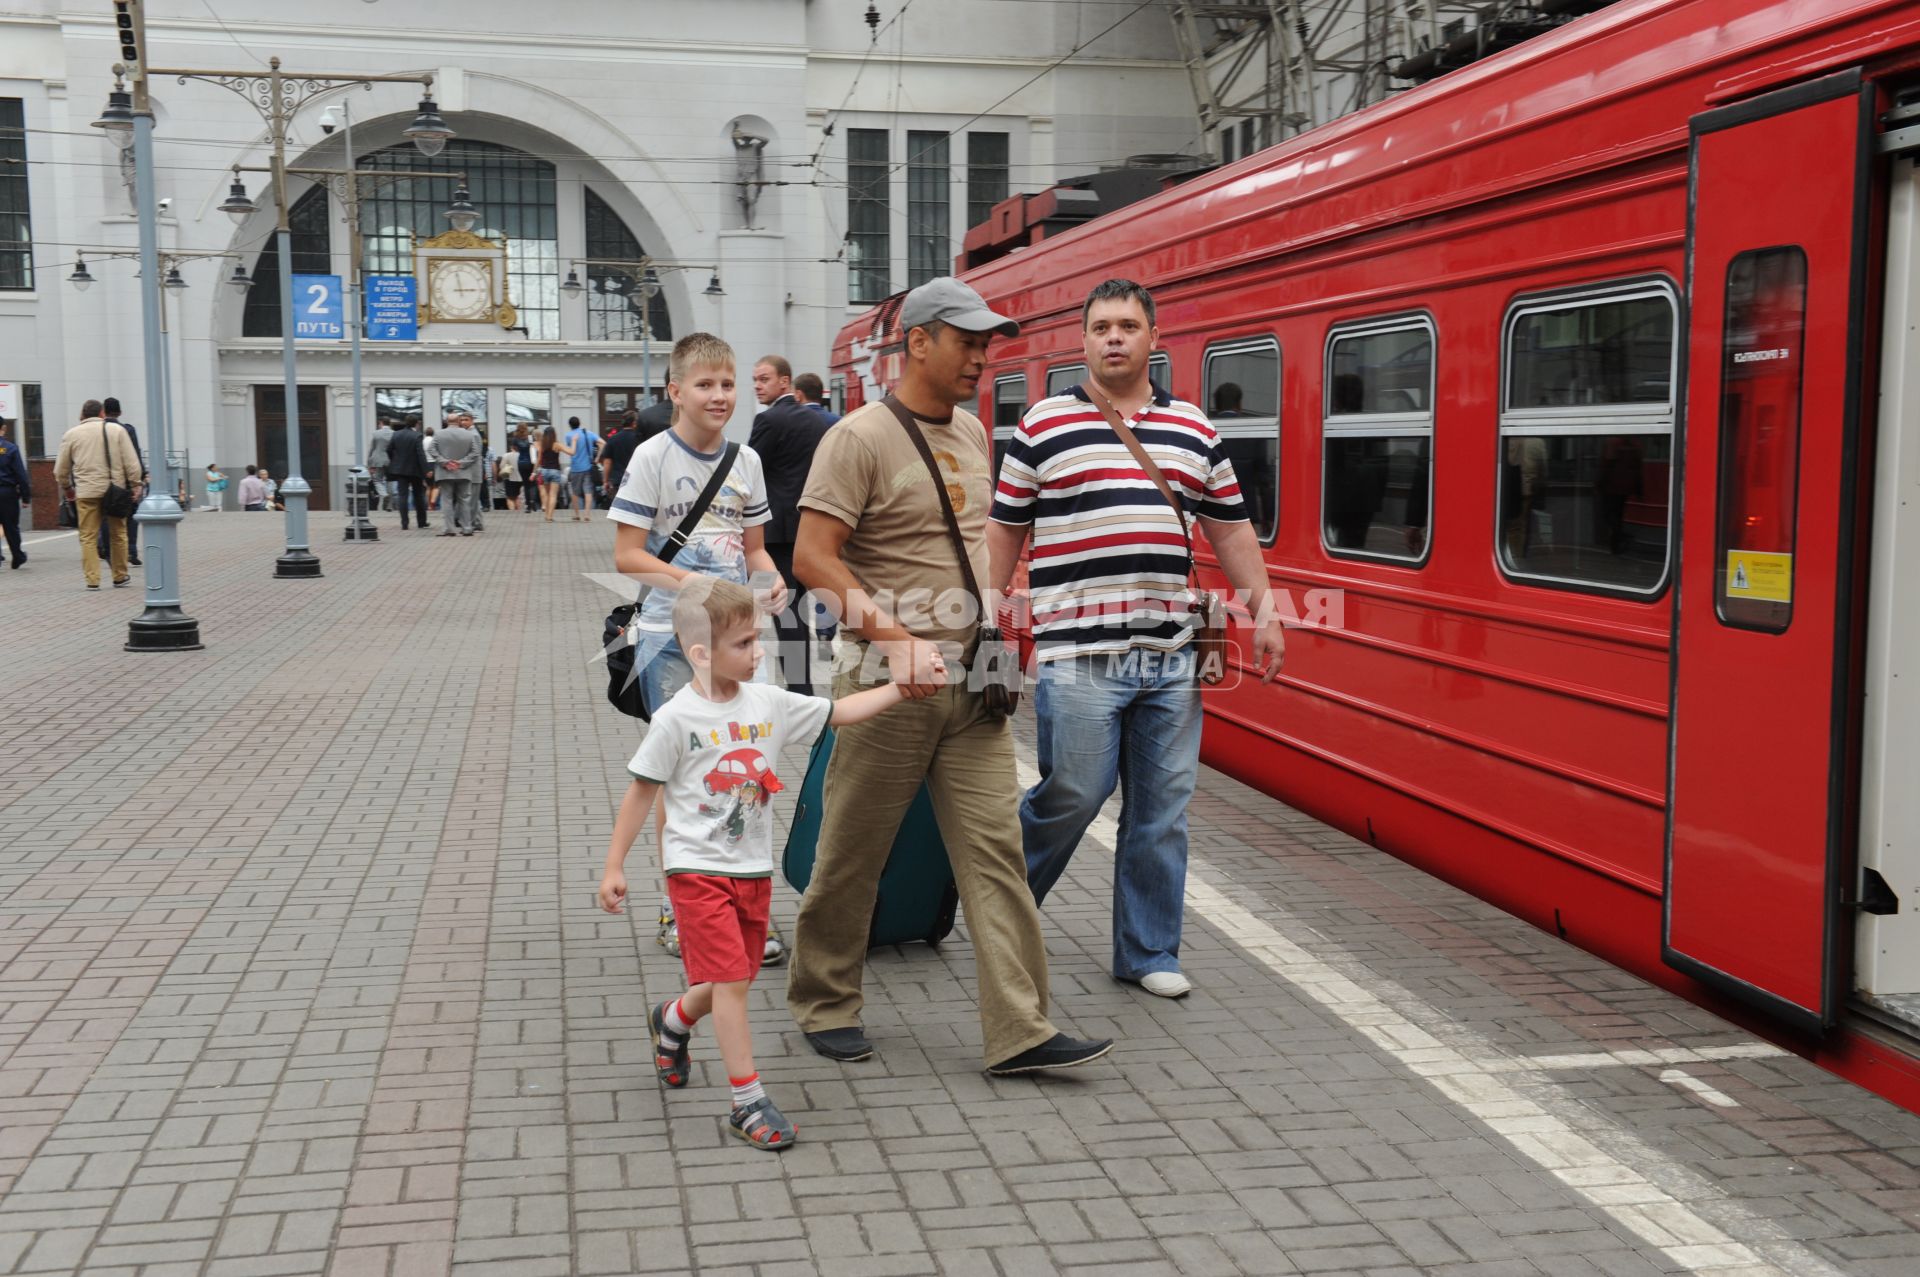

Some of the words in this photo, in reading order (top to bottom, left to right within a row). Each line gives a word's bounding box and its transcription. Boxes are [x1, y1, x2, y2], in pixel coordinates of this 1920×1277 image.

[307, 284, 329, 314] 2
[297, 321, 341, 334] ПУТЬ
[689, 729, 728, 751] Auto
